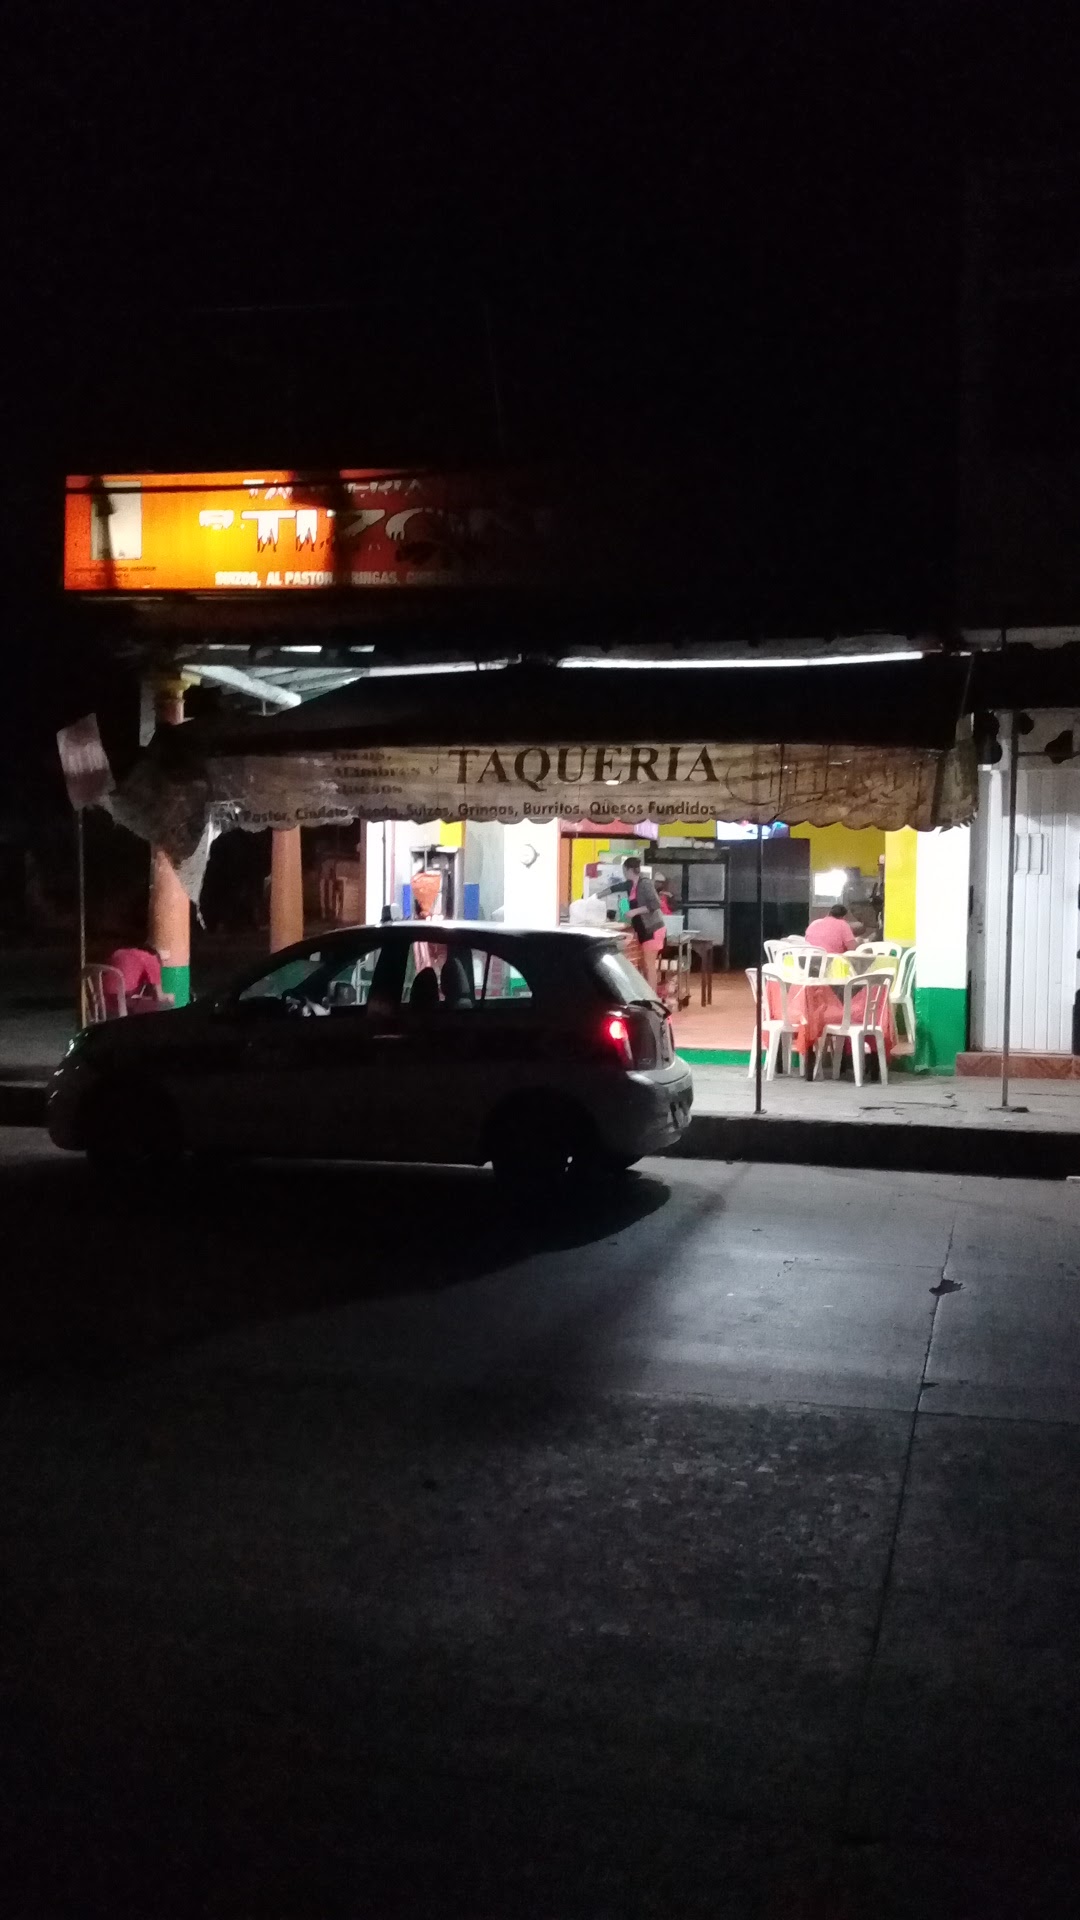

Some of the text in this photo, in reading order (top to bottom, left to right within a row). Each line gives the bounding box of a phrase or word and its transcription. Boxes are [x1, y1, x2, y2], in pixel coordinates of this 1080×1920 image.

[266, 571, 283, 586] AL
[448, 745, 720, 792] TAQUERIA
[458, 803, 518, 817] Gringas,
[590, 801, 643, 815] Quesos
[648, 801, 717, 815] Fundidos
